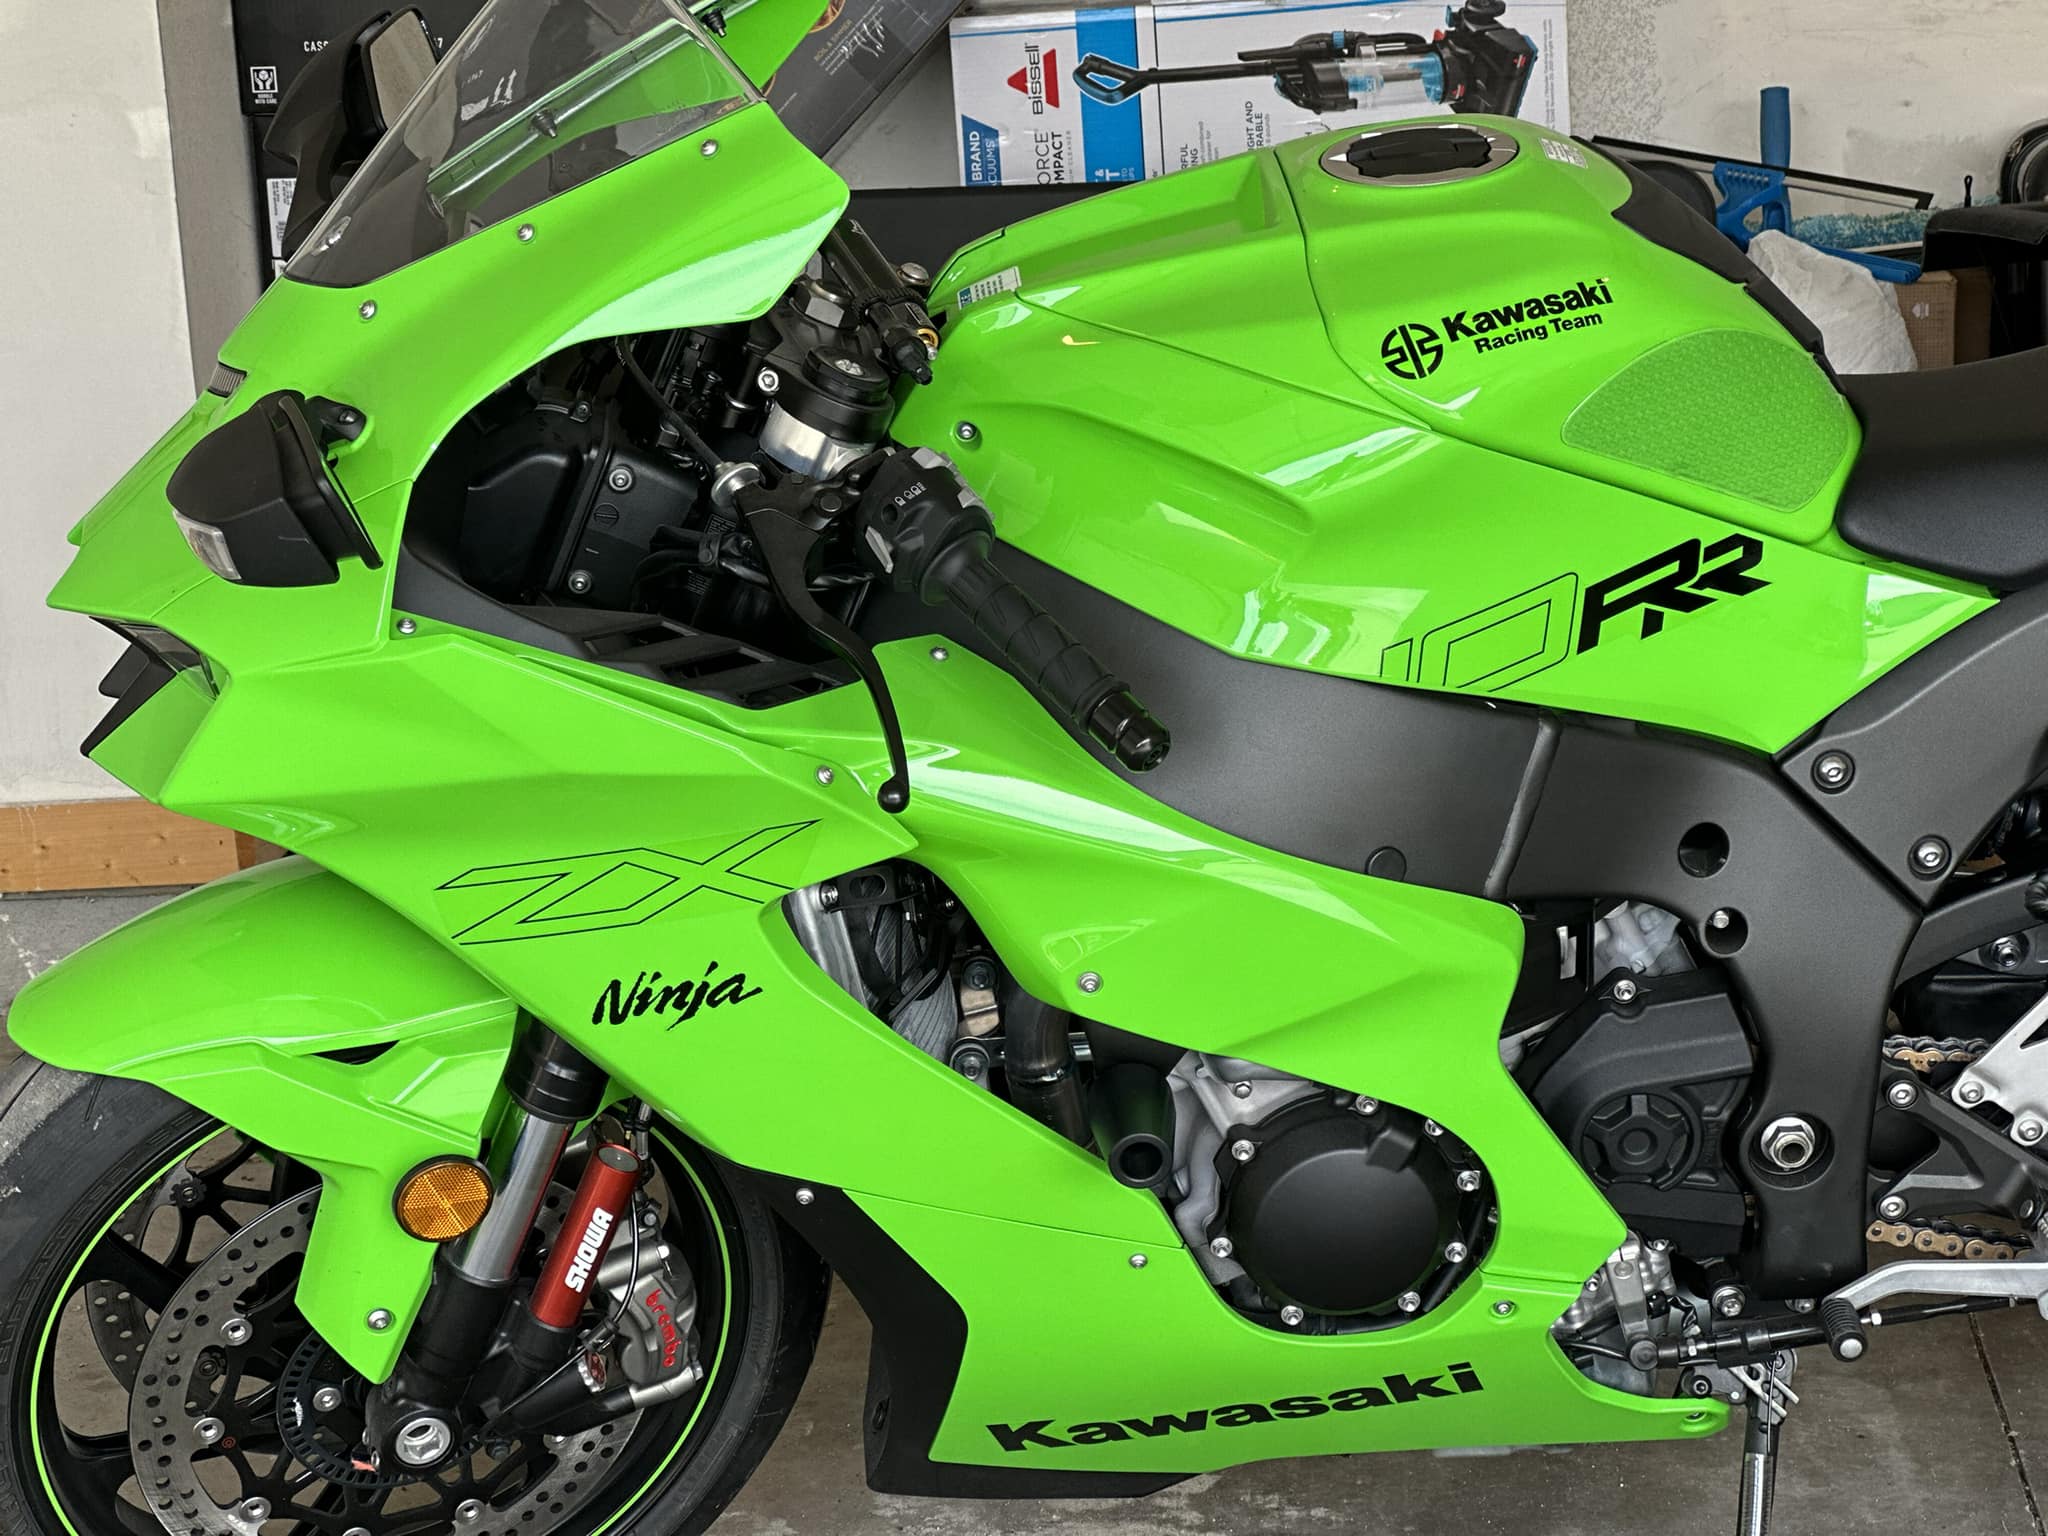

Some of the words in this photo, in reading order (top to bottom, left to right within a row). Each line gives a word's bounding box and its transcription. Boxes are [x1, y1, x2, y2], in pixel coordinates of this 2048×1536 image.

[1245, 100, 1254, 124] AND
[970, 131, 983, 181] BRAND
[985, 138, 998, 186] CUUMS
[1051, 131, 1065, 184] MPACT
[1441, 278, 1614, 342] Kawasaki
[1473, 324, 1549, 354] Racing
[1549, 312, 1604, 334] Team
[434, 818, 824, 946] ZX
[591, 961, 764, 1031] Ninja
[564, 1207, 614, 1293] SHOWA
[645, 1288, 682, 1368] brembo
[984, 1361, 1484, 1452] Kawasaki
